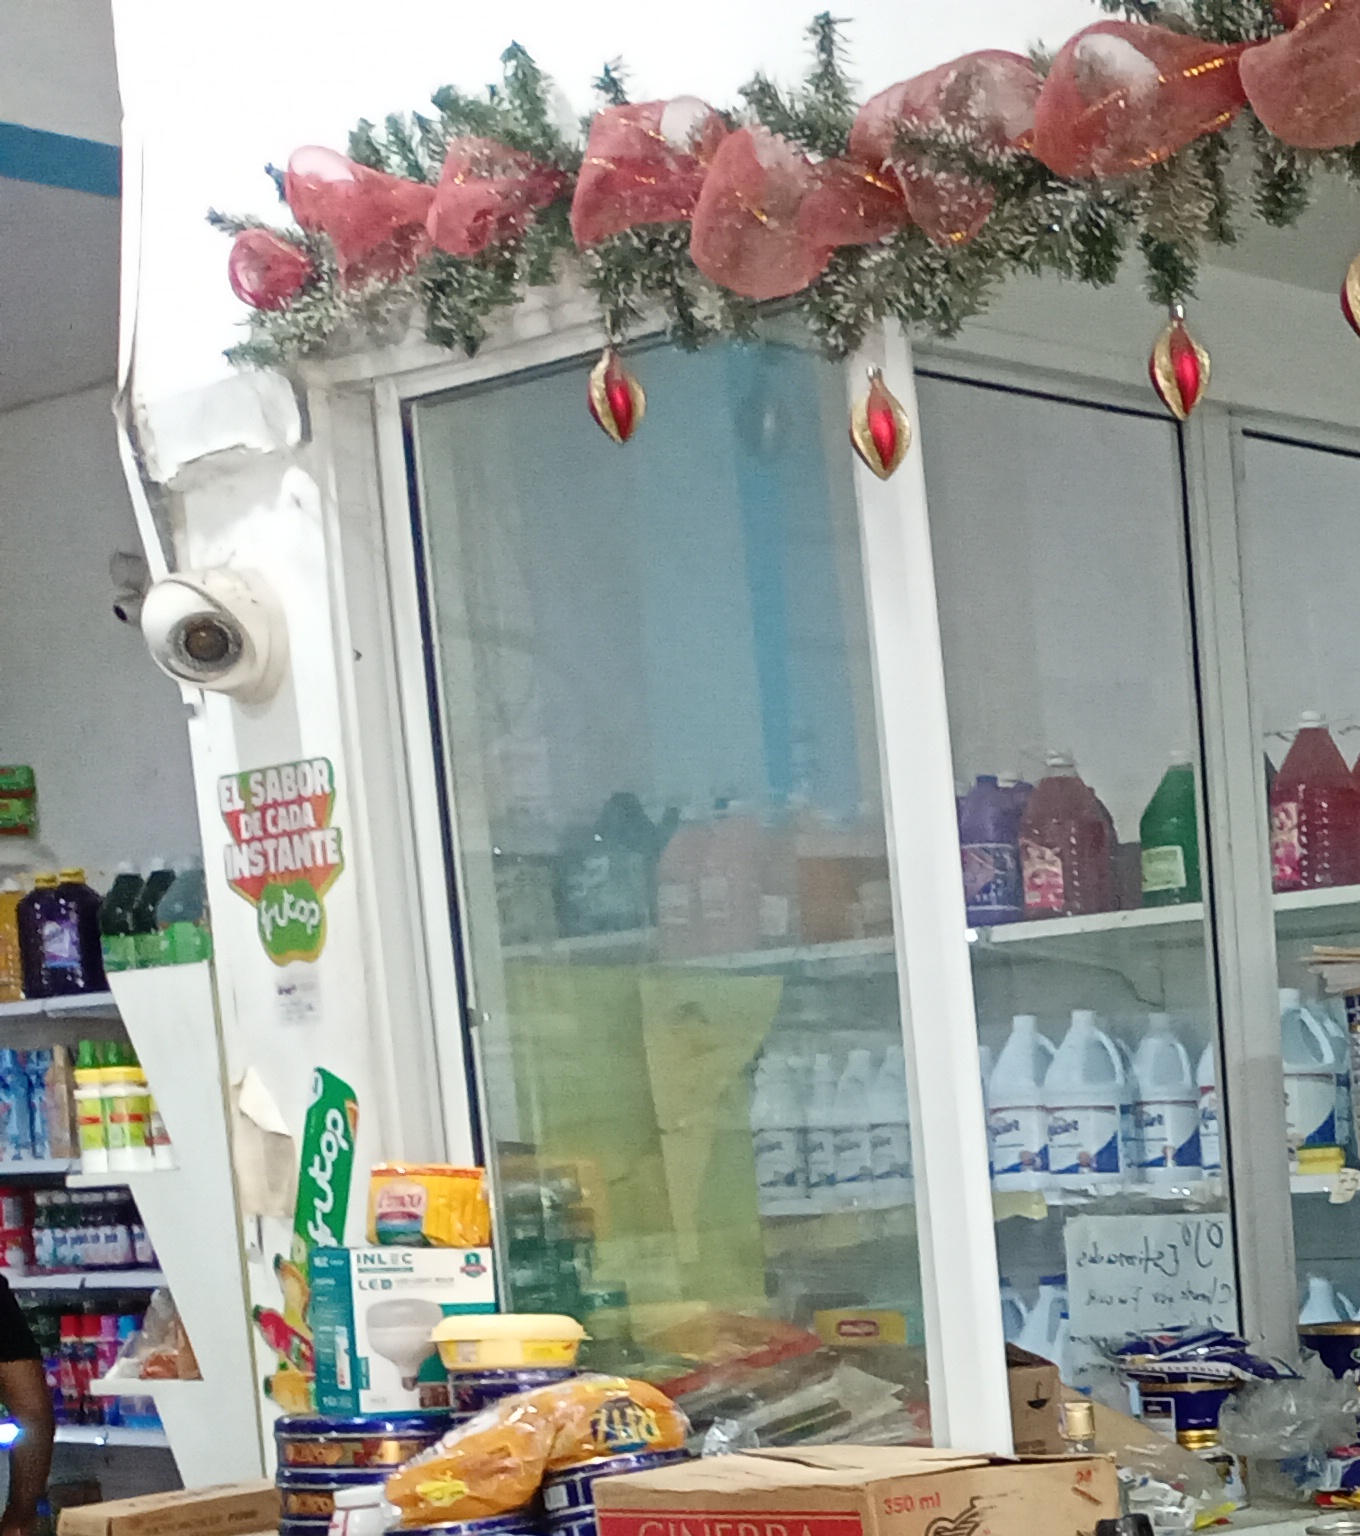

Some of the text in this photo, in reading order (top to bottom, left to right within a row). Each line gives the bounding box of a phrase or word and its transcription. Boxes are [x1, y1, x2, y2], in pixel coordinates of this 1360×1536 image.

[218, 759, 331, 812] EL SABOR
[239, 802, 315, 839] DE CADA
[224, 827, 340, 880] INSTANTE
[884, 1492, 941, 1515] 350 ml
